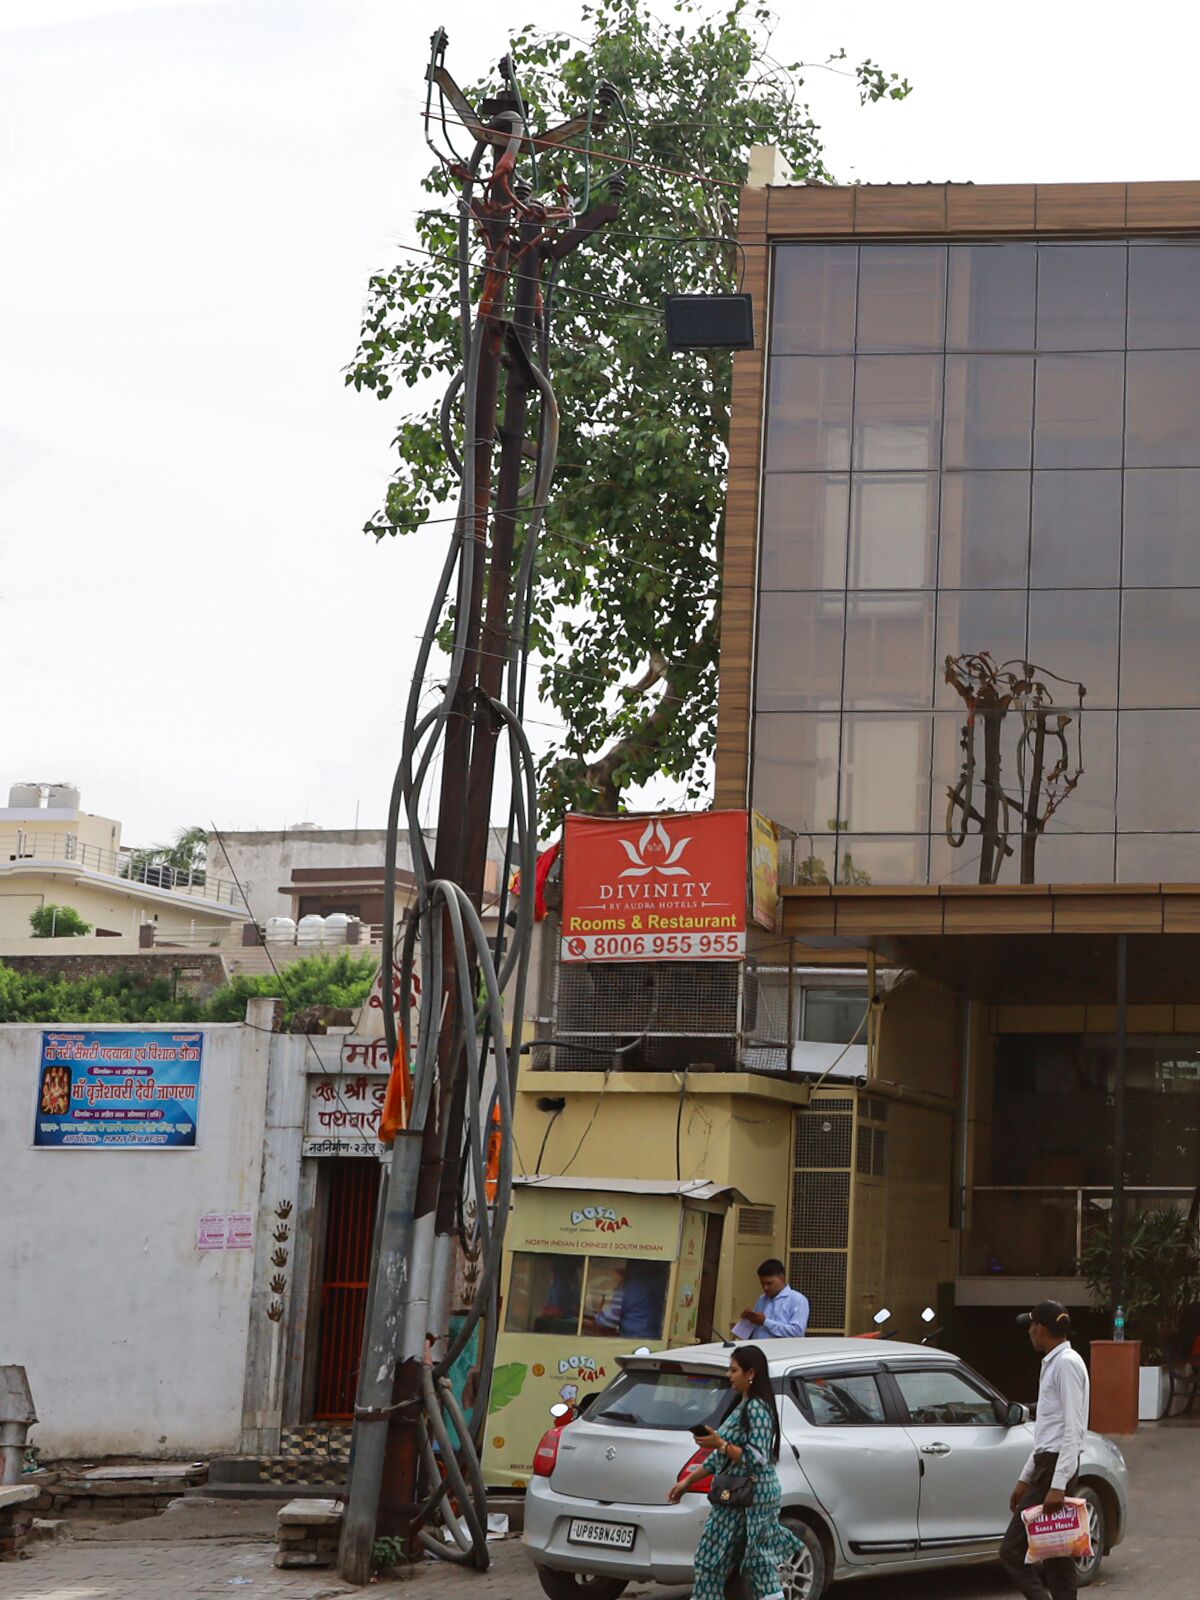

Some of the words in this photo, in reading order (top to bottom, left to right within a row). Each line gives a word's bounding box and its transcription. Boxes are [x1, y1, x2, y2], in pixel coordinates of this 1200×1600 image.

[599, 882, 712, 900] DIVINITY
[609, 902, 621, 910] BY
[659, 901, 697, 909] HOTELS
[570, 917, 626, 931] Rooms
[631, 917, 643, 930] &
[648, 914, 737, 930] Restaurant
[594, 937, 645, 956] 8006
[653, 935, 692, 954] 955
[699, 934, 738, 953] 955
[135, 1078, 155, 1102] देवी
[156, 1083, 195, 1100] जागरण
[344, 1076, 368, 1101] श्री
[571, 1206, 618, 1226] DOSA
[595, 1216, 630, 1233] PLAZA
[525, 1239, 549, 1247] NORTH
[551, 1239, 575, 1247] INDIAN
[580, 1241, 608, 1249] CHINESE
[614, 1242, 638, 1250] SOUTH
[639, 1243, 663, 1251] INDIAN
[558, 1355, 596, 1374] DOSA
[578, 1366, 606, 1383] PLAZA
[576, 1523, 633, 1544] UP85BN4905
